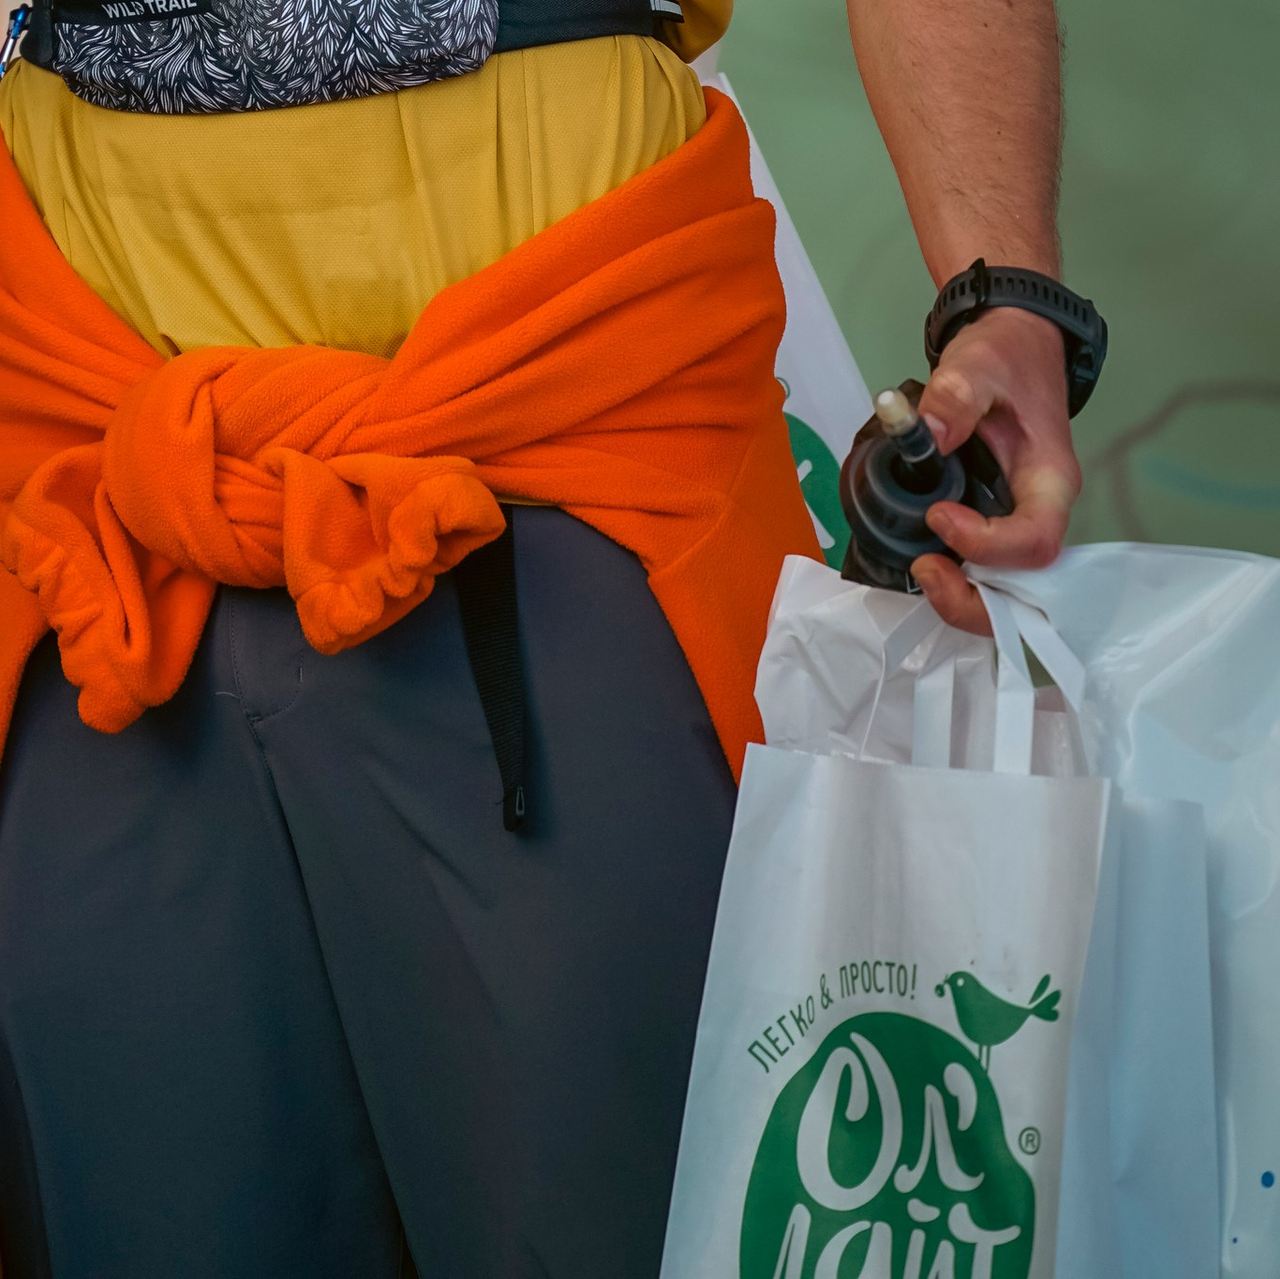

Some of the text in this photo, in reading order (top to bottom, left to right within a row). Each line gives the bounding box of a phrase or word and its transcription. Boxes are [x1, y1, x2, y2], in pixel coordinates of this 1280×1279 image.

[101, 1, 145, 18] WILD
[747, 960, 917, 1074] ЛЕГКО & ПРОСТО!
